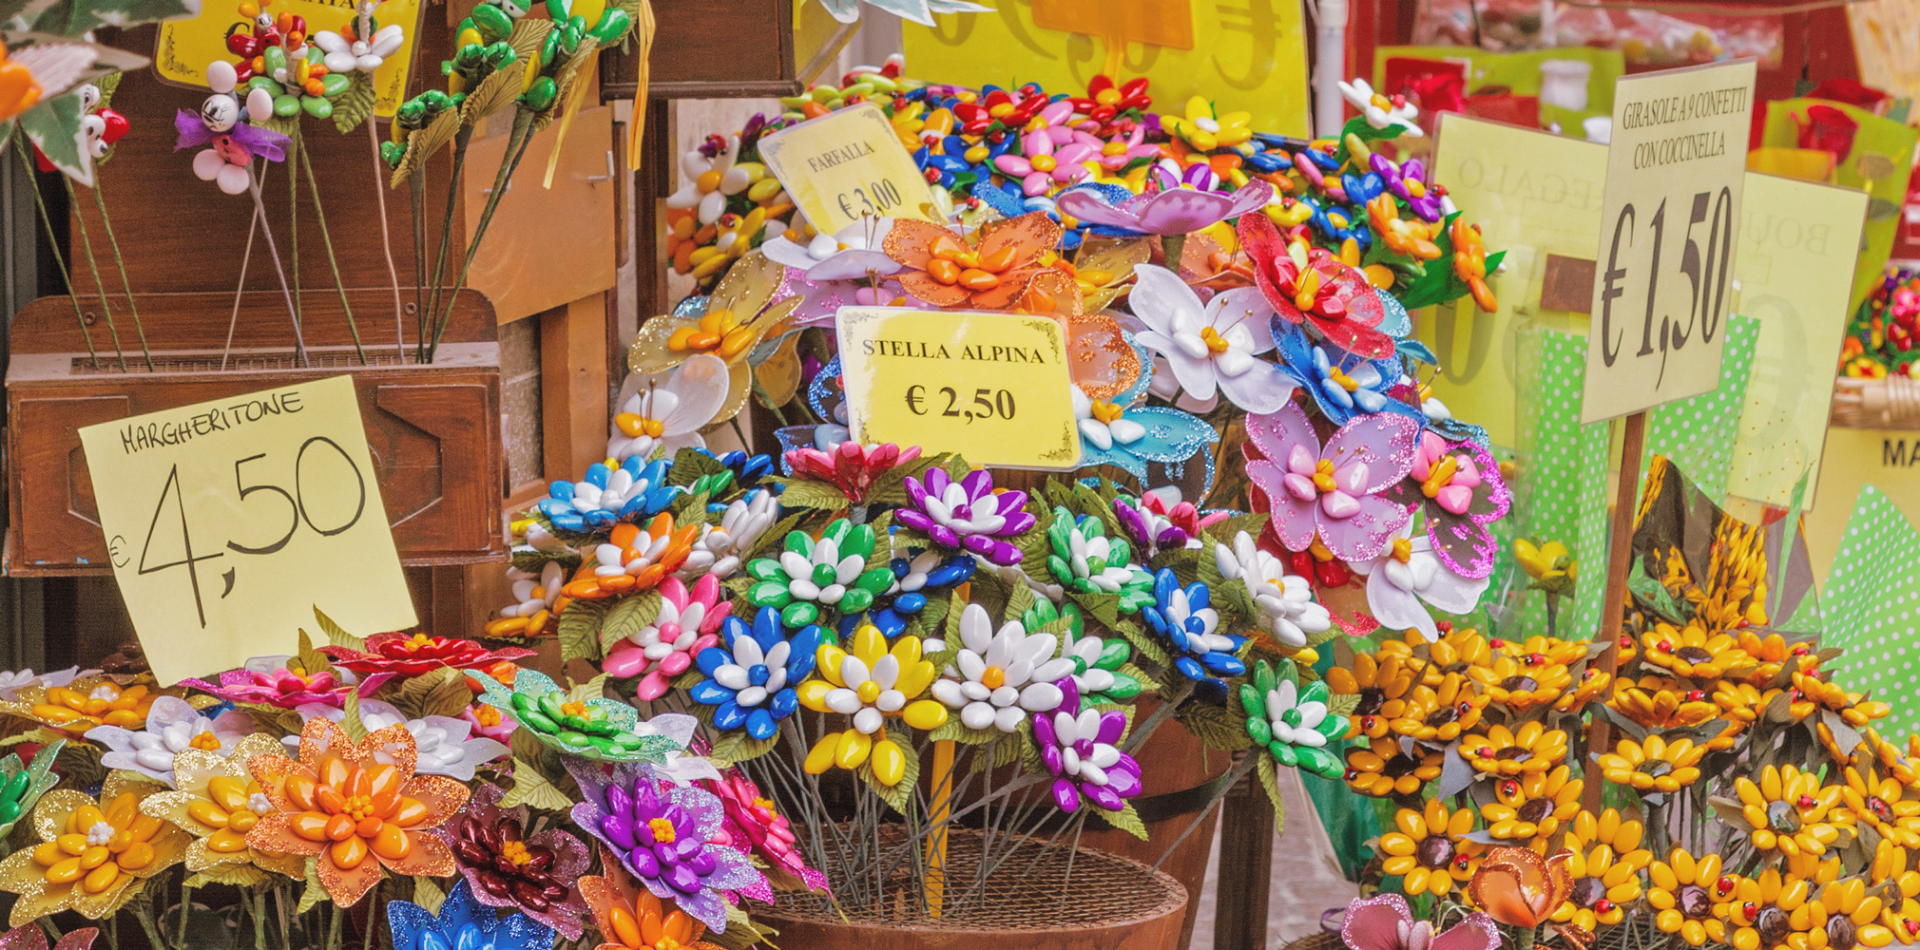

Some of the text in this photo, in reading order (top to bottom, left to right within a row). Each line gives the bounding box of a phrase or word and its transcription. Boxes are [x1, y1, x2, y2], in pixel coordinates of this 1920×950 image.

[1622, 86, 1748, 130] GIRASOLE A 9 CONFETTI
[807, 140, 876, 173] FARFALLA
[1633, 130, 1726, 170] CON COCCINELLA
[837, 178, 902, 221] € 3,00
[1601, 203, 1636, 368] €
[1636, 185, 1732, 393] 1,50
[862, 339, 1046, 365] STELLA ALPINA
[119, 390, 304, 455] MARGHERITONE
[904, 384, 1016, 425] € 2,50
[108, 435, 366, 629] € 4,50
